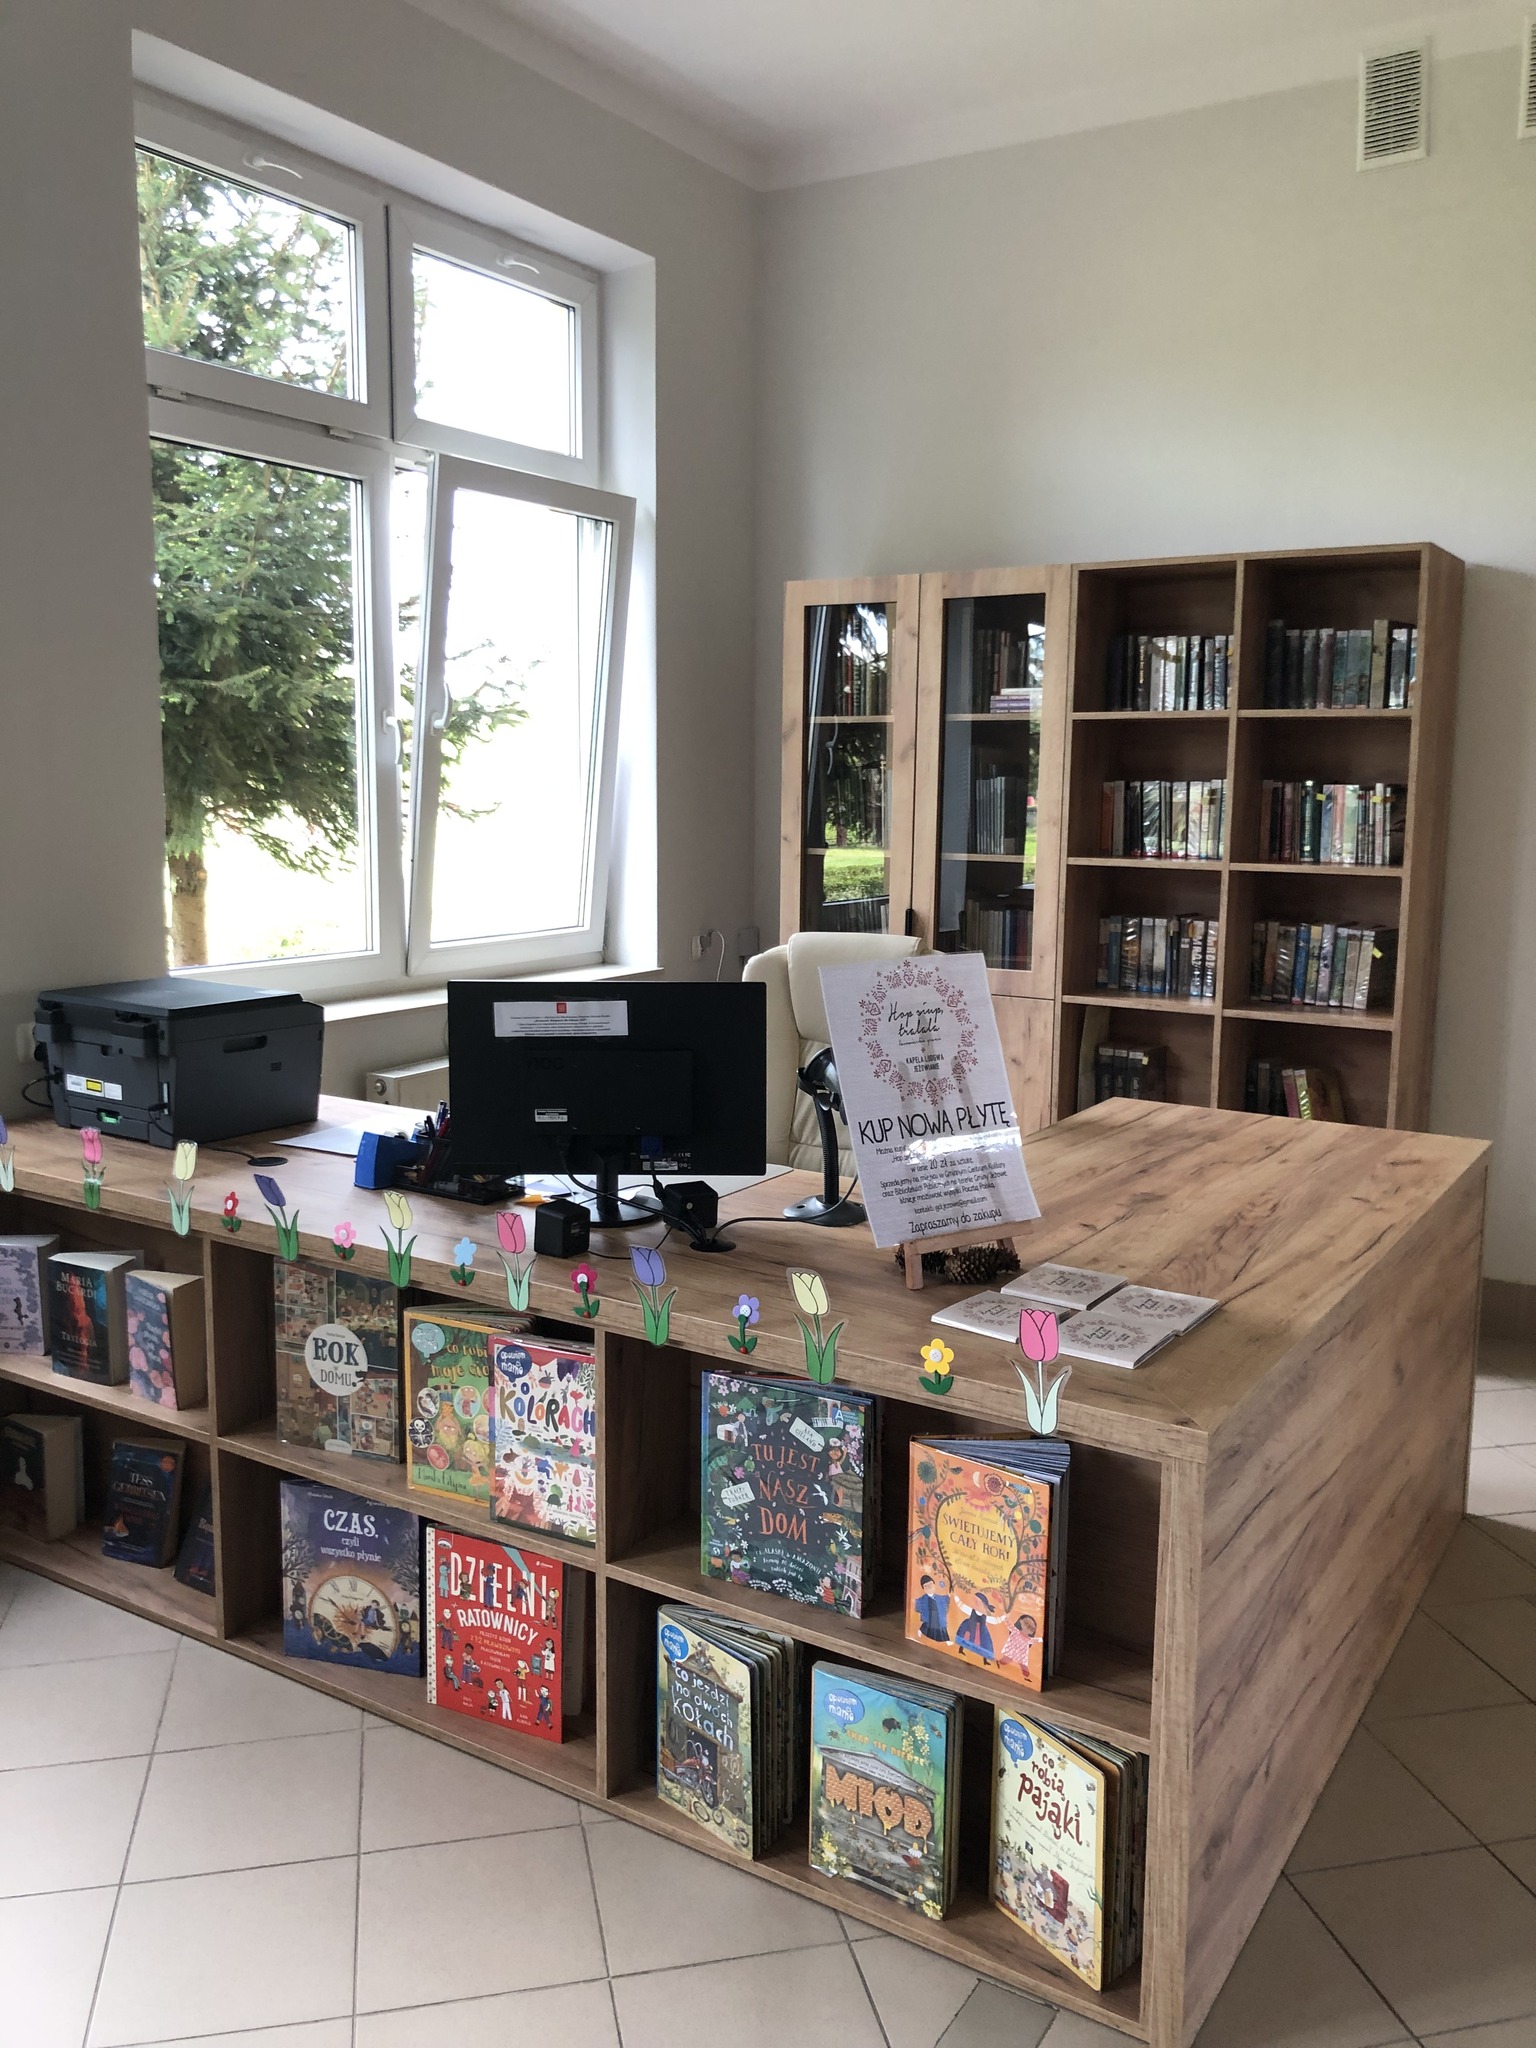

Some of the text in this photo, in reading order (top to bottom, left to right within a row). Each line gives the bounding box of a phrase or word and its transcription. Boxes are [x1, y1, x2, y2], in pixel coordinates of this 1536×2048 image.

[888, 1001, 913, 1027] Hop
[898, 1018, 940, 1037] tralala
[906, 1054, 944, 1064] KAPELA LUDOWA
[858, 1118, 893, 1145] KUP
[897, 1110, 955, 1139] NOWĄ
[956, 1101, 1011, 1131] PŁYTĘ
[929, 1159, 938, 1170] 20
[940, 1157, 948, 1169] zł
[908, 1208, 1003, 1235] Zapraszamy do zakupu
[313, 1337, 360, 1366] ROK
[446, 1344, 459, 1354] co
[431, 1364, 465, 1384] moje
[500, 1386, 595, 1437] KOLORACH
[751, 1444, 820, 1473] TU JEST
[758, 1471, 808, 1505] NASZ
[757, 1505, 808, 1545] DOM
[320, 1546, 382, 1562] wszystko płynie
[341, 1536, 360, 1547] czyli
[983, 1543, 1010, 1561] ROK!
[450, 1552, 547, 1621] DZIELNI
[457, 1609, 539, 1646] RATOWNICY
[675, 1667, 689, 1682] co
[671, 1684, 734, 1752] kołach
[675, 1680, 733, 1729] na dwóch
[829, 1704, 854, 1721] mamo
[1042, 1753, 1055, 1769] co
[1032, 1761, 1066, 1801] robią
[1018, 1773, 1083, 1845] pająki
